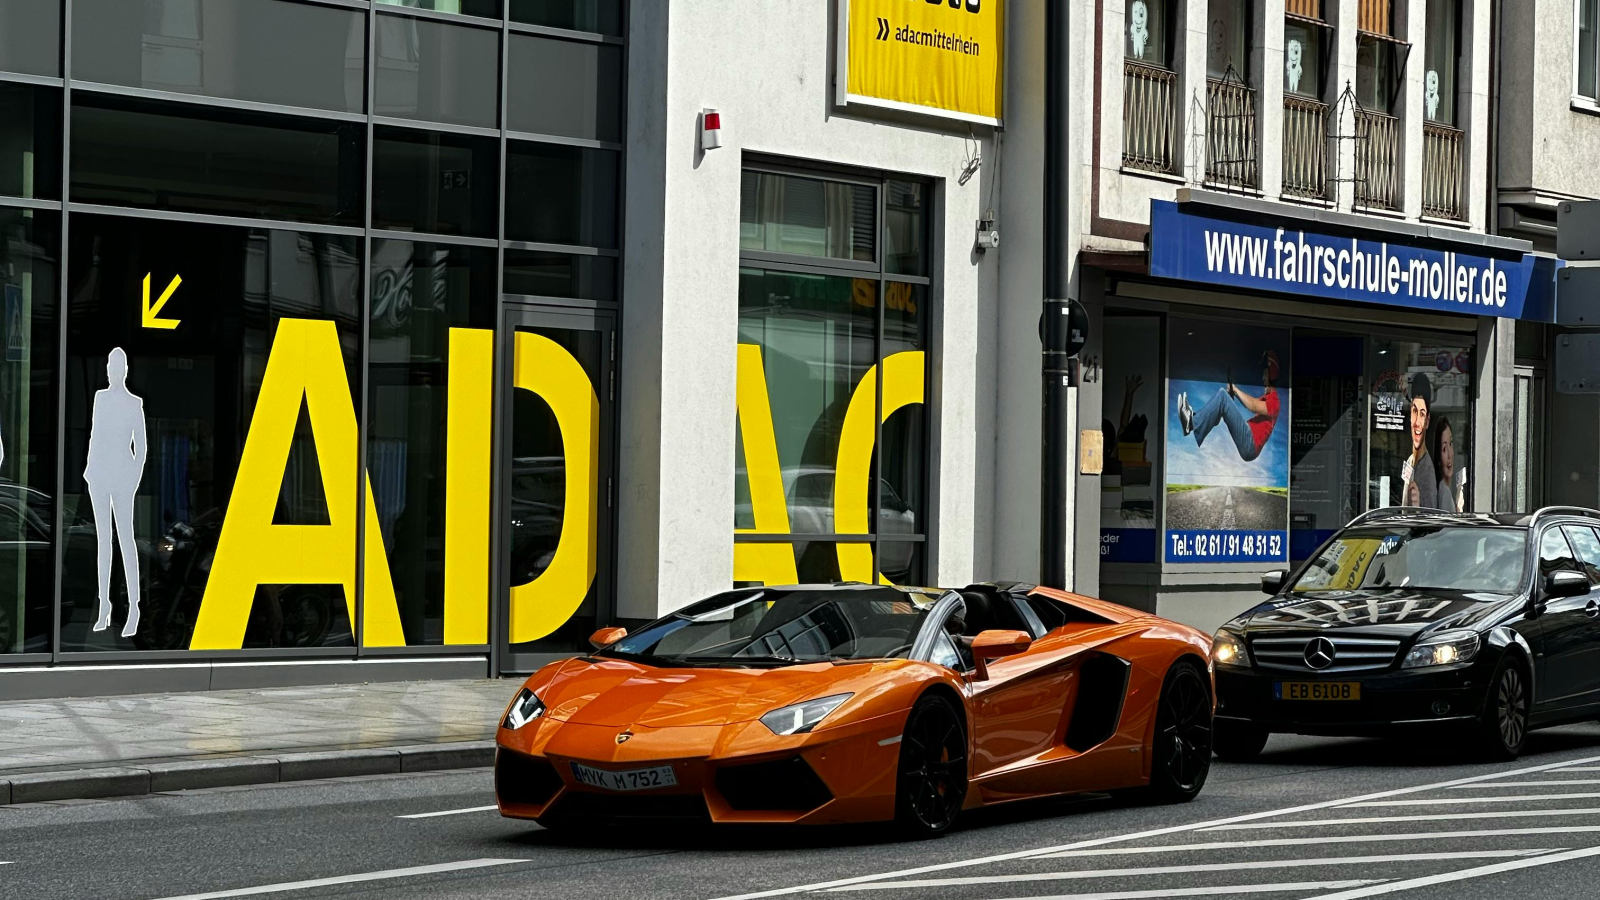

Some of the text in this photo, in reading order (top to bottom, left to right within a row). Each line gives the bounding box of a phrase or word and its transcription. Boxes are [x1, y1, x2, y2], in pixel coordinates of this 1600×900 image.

[895, 24, 980, 57] adacmittelrhein
[1204, 226, 1508, 308] www.fahrschule-moller.de
[1292, 431, 1322, 445] SHOP
[1099, 533, 1120, 543] eder
[1172, 534, 1193, 556] Tel.:
[1195, 534, 1207, 556] 02
[1209, 534, 1220, 556] 61
[1228, 535, 1240, 556] 91
[1242, 535, 1254, 556] 48
[1256, 535, 1267, 556] 51
[1269, 535, 1281, 556] 52
[1100, 545, 1110, 555] ß!
[1290, 683, 1351, 699] EB 6108
[613, 774, 627, 789] M
[628, 770, 662, 788] 752
